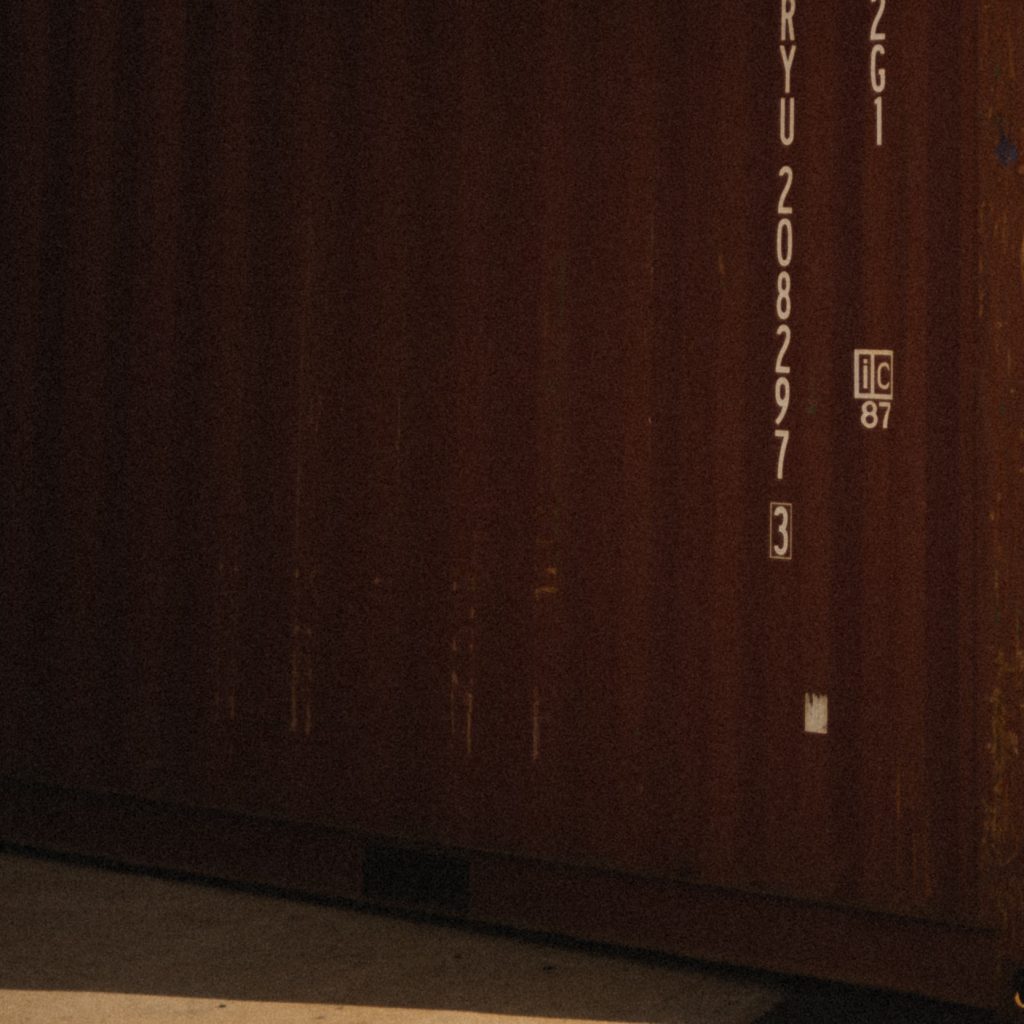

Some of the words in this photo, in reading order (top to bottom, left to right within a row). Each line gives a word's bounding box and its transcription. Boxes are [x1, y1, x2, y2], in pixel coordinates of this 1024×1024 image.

[774, 165, 794, 480] 208297
[860, 400, 892, 429] 87
[773, 505, 789, 557] 3
